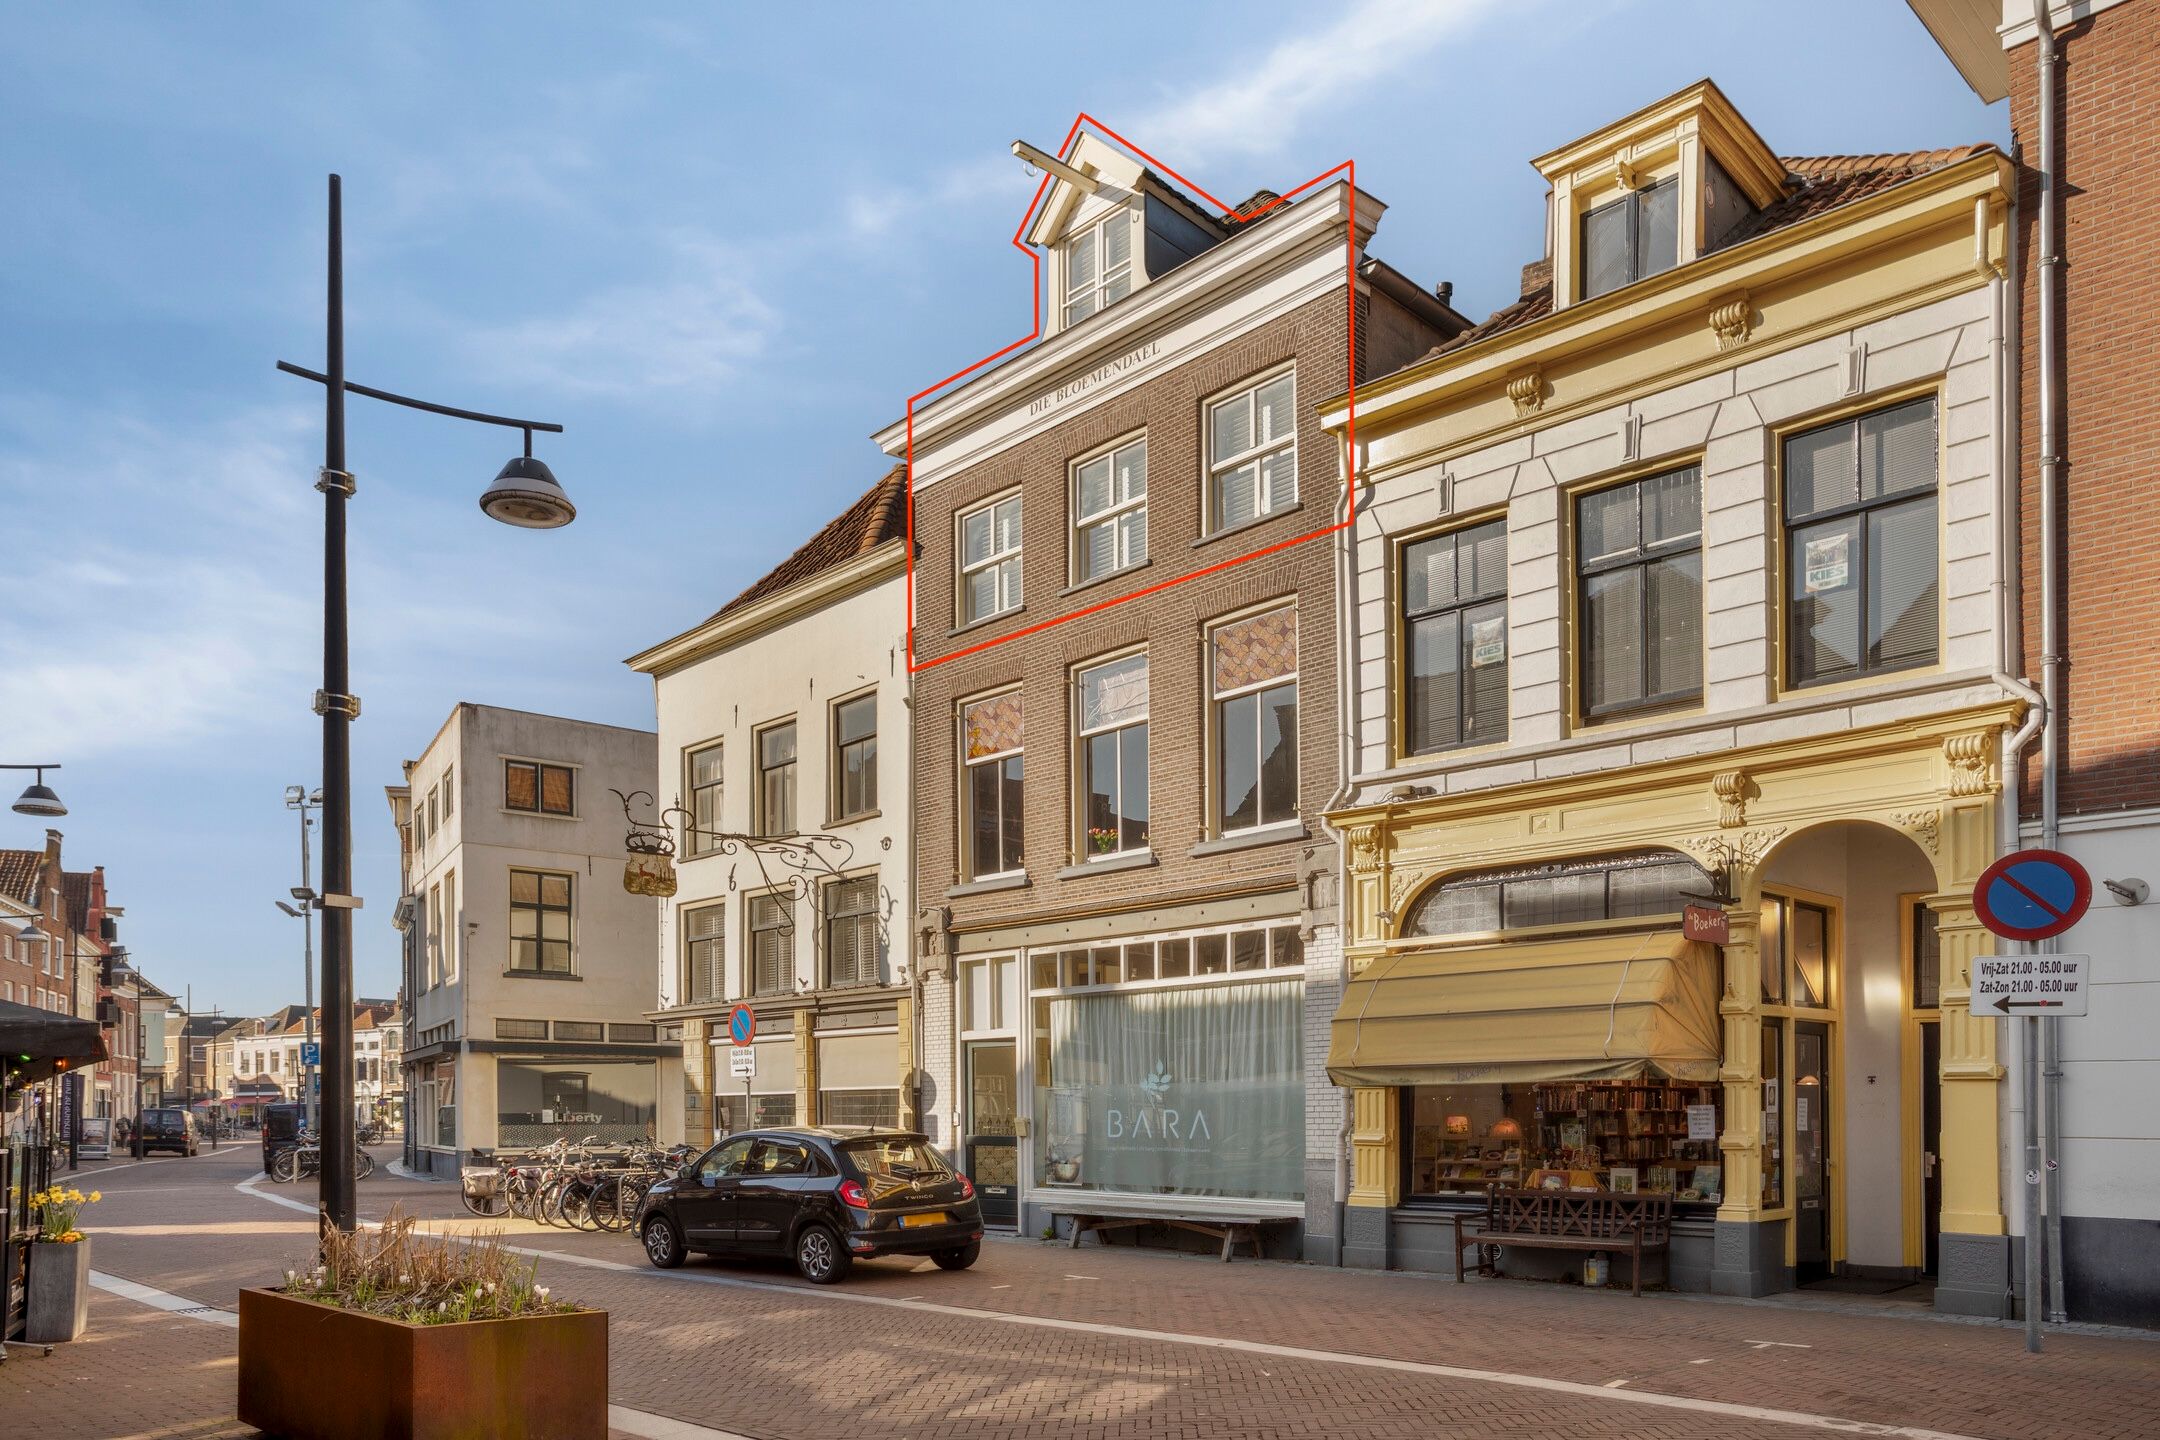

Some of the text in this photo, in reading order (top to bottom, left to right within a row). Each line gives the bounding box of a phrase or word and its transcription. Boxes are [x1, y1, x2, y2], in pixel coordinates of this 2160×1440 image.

[1029, 342, 1161, 416] DIE BLOEMENDAEL
[1810, 565, 1845, 582] KIES
[1476, 644, 1501, 658] KIES
[1981, 962, 2009, 978] Vrij-Zat
[2011, 962, 2033, 974] 21.00
[2039, 961, 2061, 974] 05.00
[2063, 963, 2078, 974] uur
[1980, 981, 2010, 993] Zat-Zon
[2011, 980, 2033, 992] 21.00
[2040, 980, 2062, 992] 05.00
[2064, 982, 2078, 992] uur
[305, 1044, 316, 1056] P
[554, 1109, 602, 1124] Liberty
[1107, 1109, 1211, 1140] BARA
